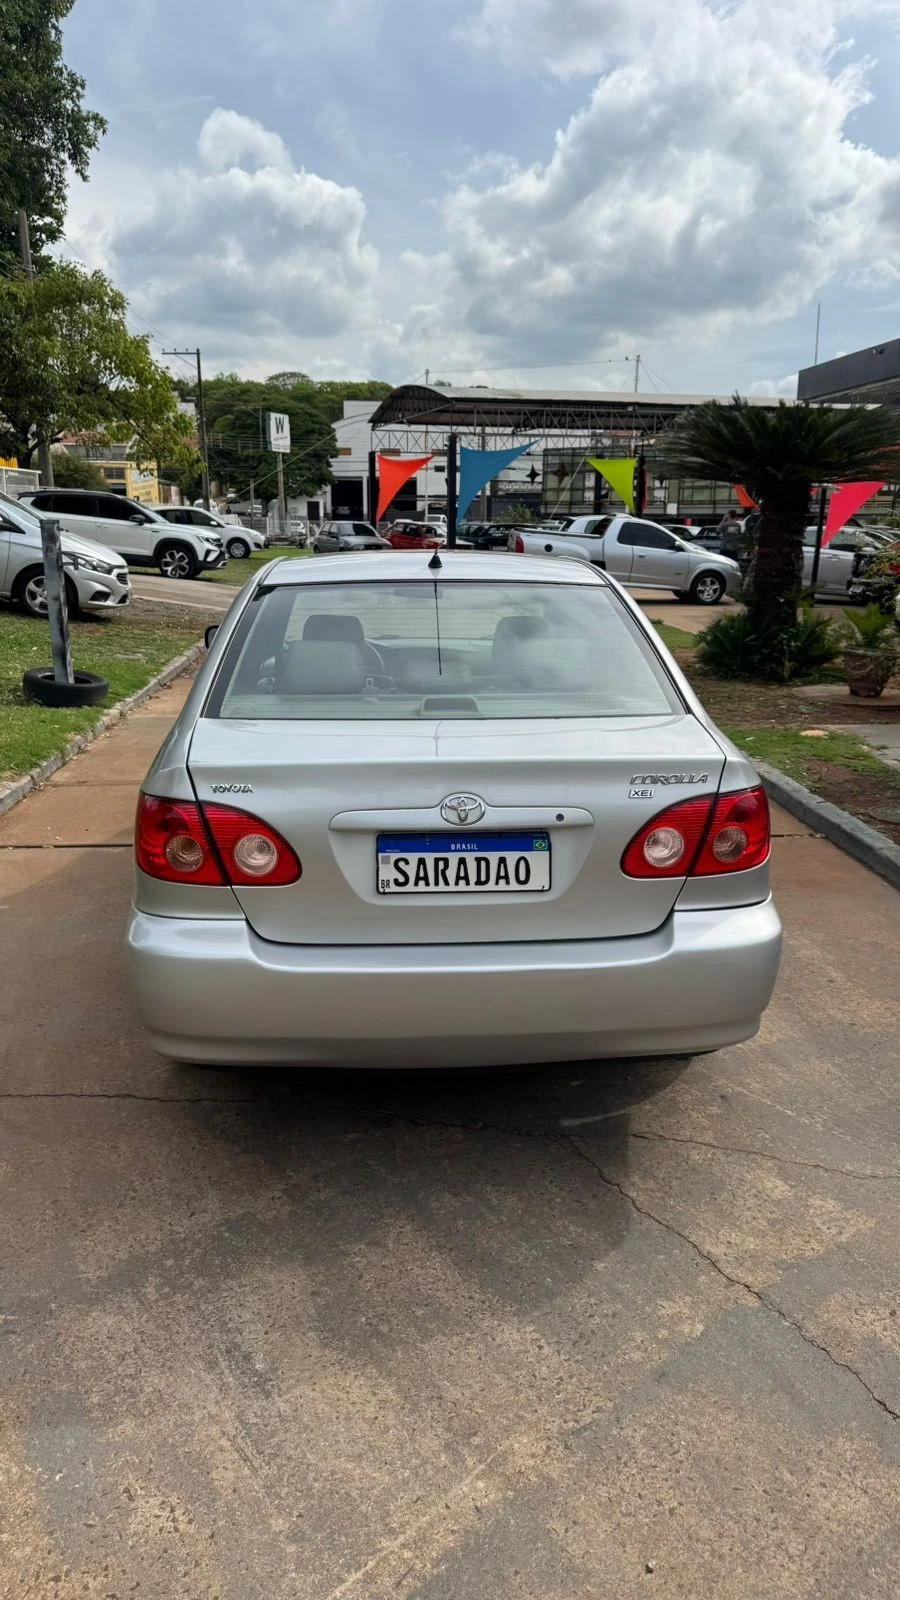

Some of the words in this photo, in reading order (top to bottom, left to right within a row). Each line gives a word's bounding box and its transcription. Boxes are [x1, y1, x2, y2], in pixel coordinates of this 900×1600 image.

[274, 416, 285, 434] W
[630, 773, 708, 785] COROLLA
[210, 783, 254, 793] TOYOTA
[393, 856, 531, 887] SARADAO
[380, 879, 391, 889] BR
